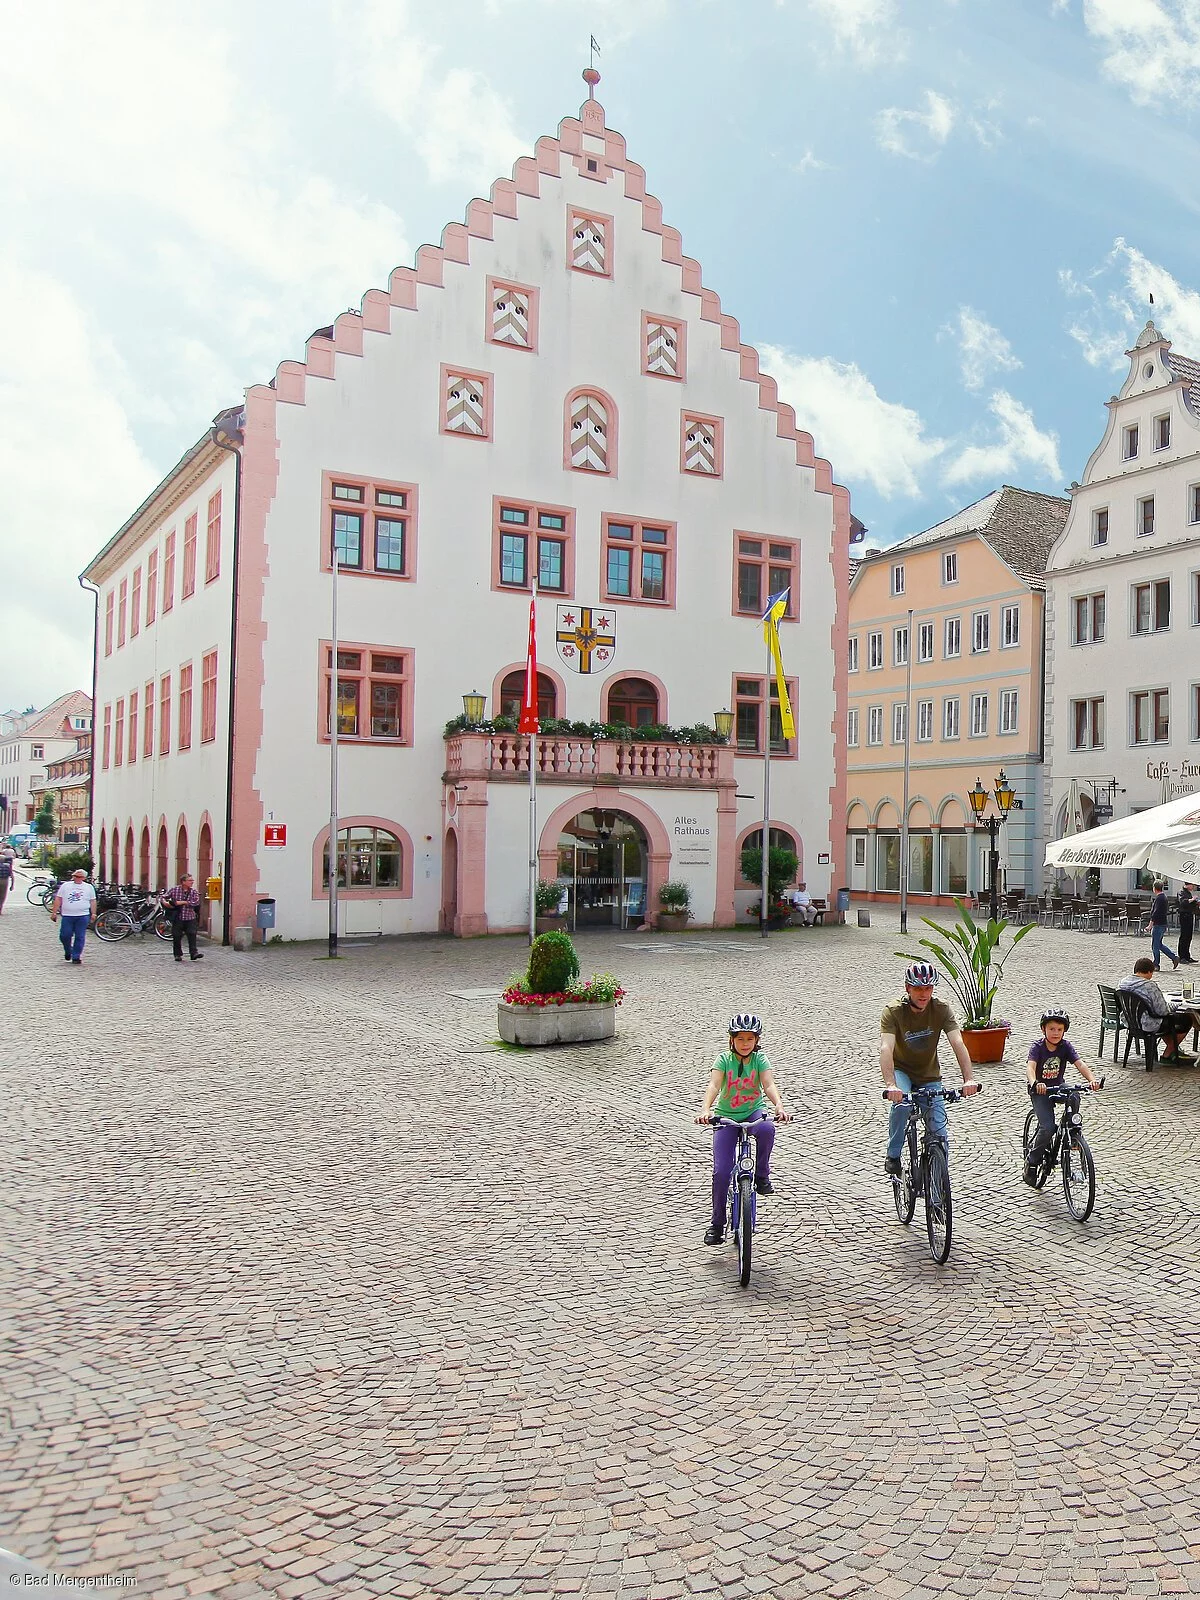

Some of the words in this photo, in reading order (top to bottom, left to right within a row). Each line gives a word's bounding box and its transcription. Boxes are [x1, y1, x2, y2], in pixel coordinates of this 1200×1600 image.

[1146, 761, 1169, 781] Café
[268, 811, 274, 820] 1
[674, 816, 697, 825] Altes
[674, 826, 710, 835] Rathaus
[1057, 848, 1127, 866] Herbsthäuser
